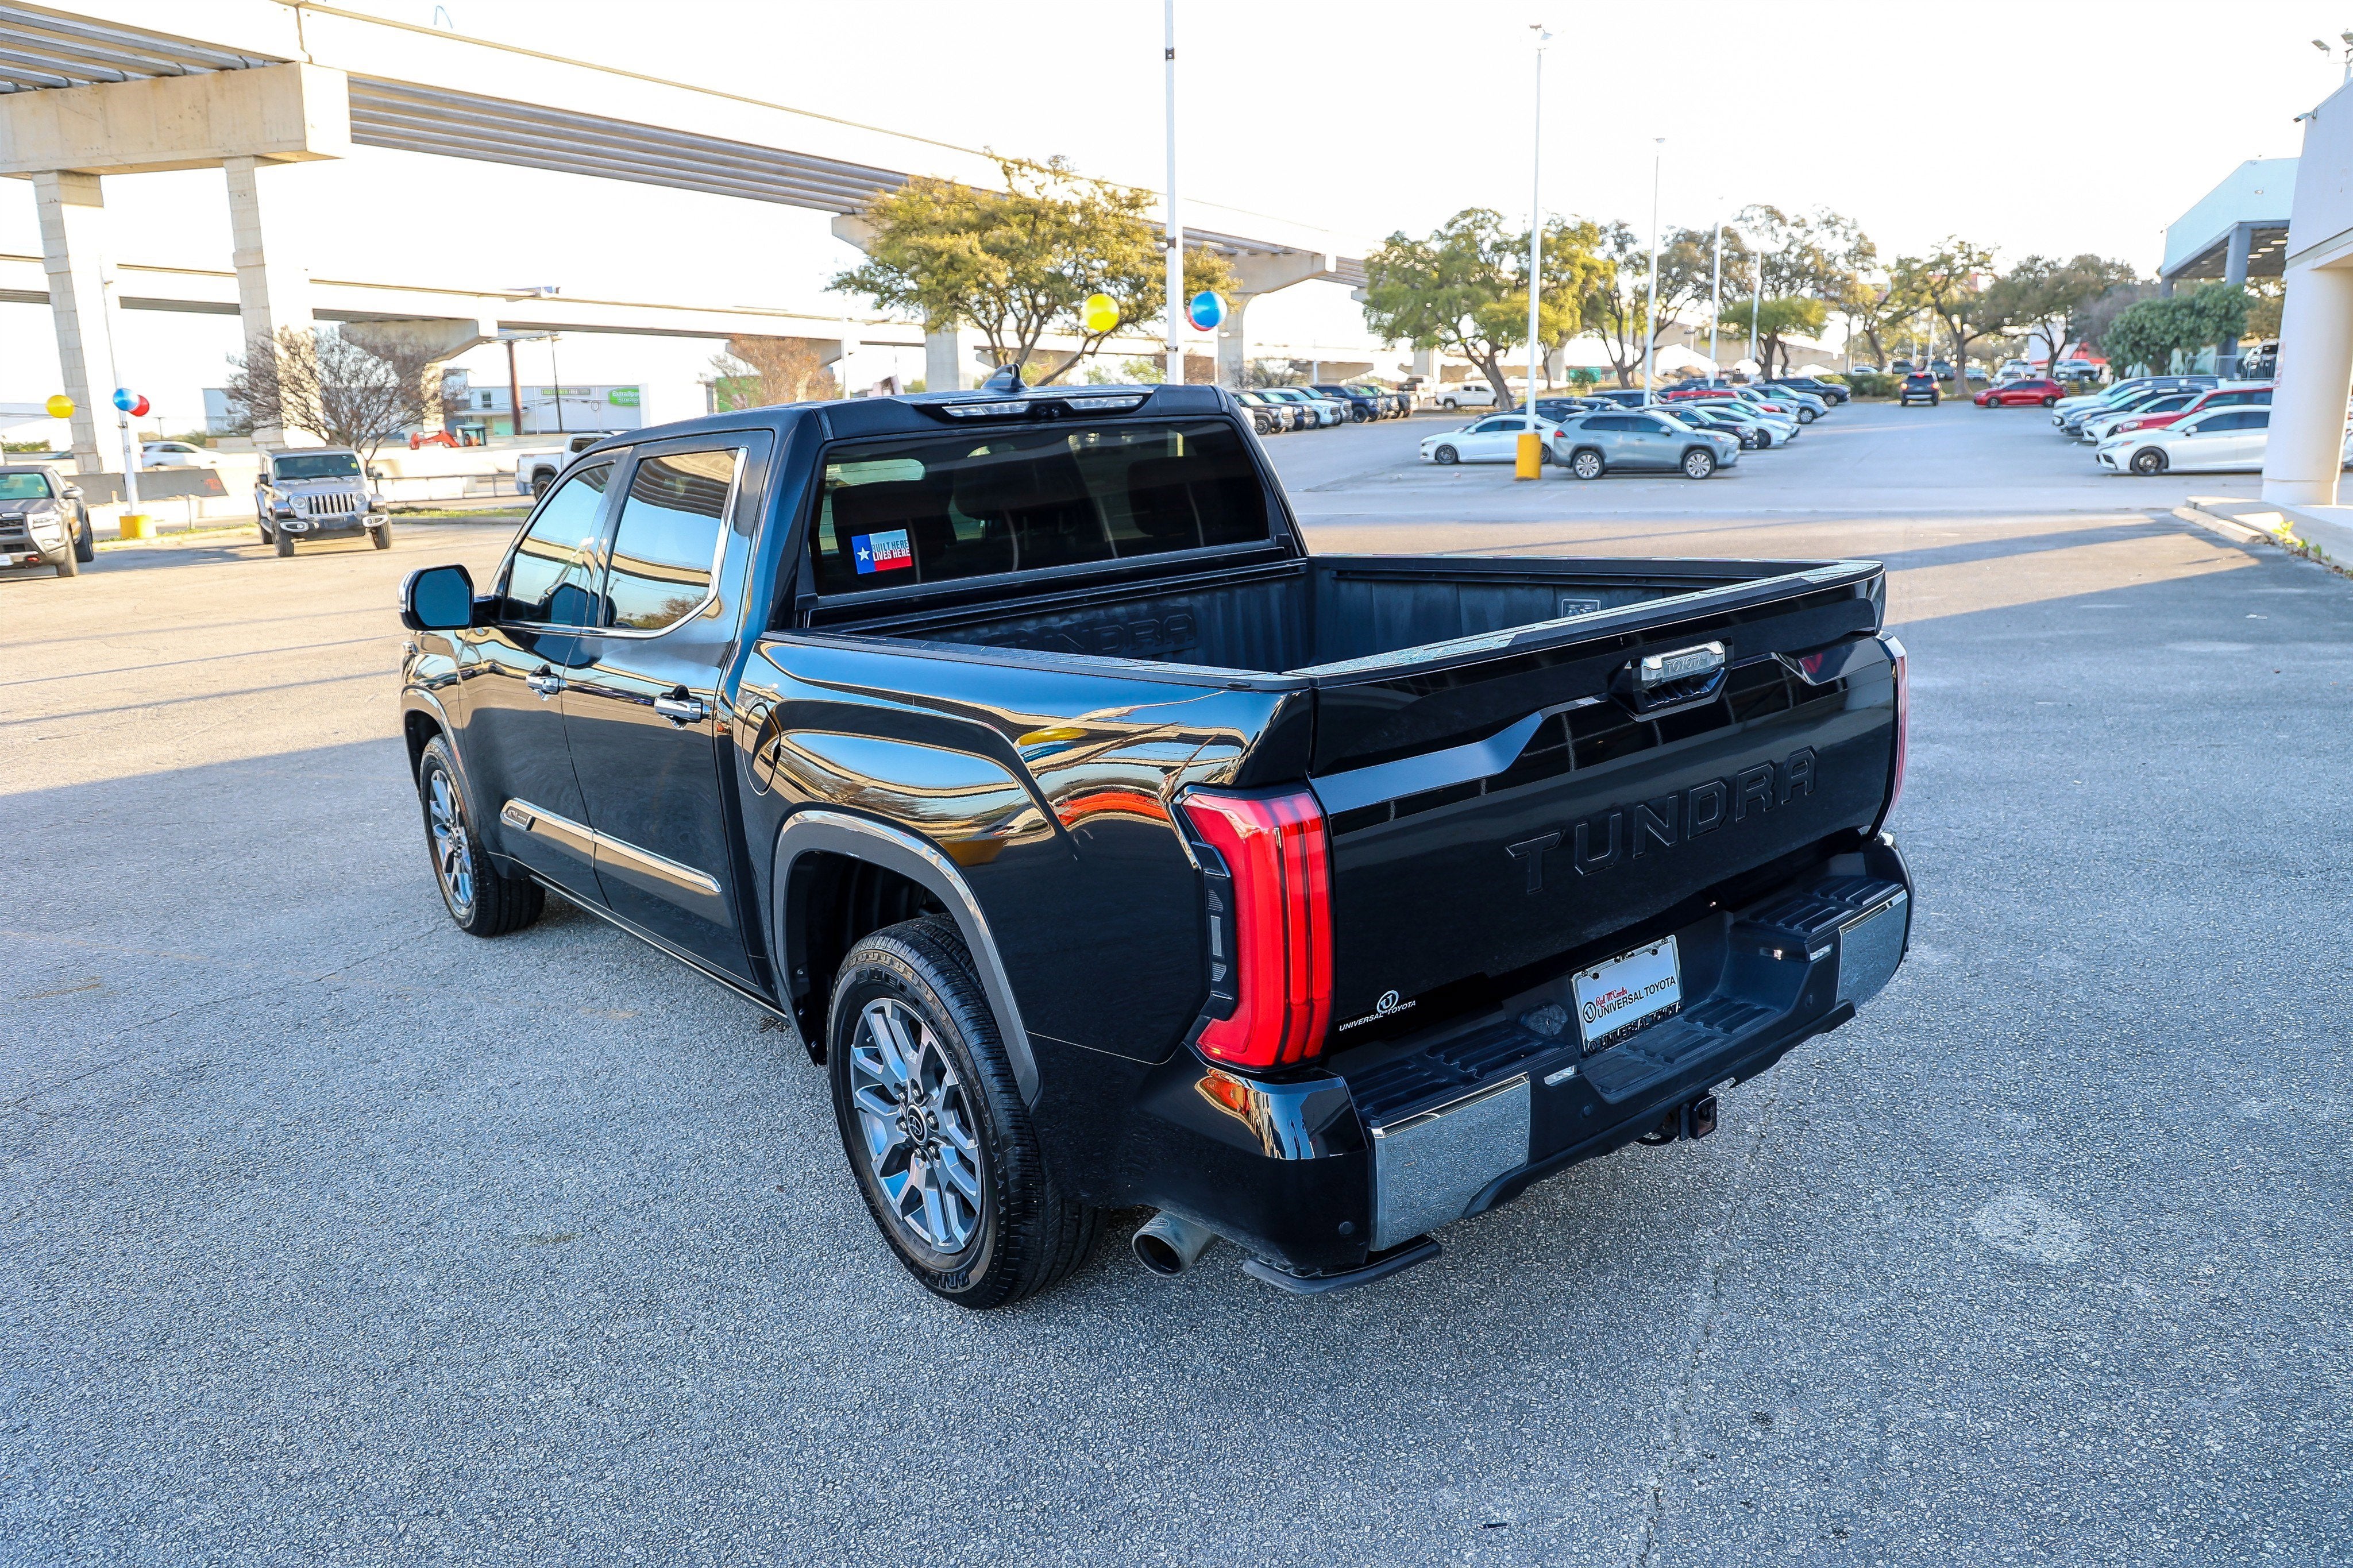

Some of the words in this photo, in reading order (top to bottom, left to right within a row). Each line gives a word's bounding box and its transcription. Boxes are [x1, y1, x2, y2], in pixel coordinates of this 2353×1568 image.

[872, 542, 891, 552] BUILT
[891, 539, 908, 550] HERE
[873, 550, 892, 561] LIVES
[892, 548, 911, 558] HERE
[1667, 655, 1703, 673] TOYOTA
[1506, 745, 1817, 894] TUNDRA
[1596, 996, 1606, 1008] Red
[1598, 990, 1644, 1018] UNIVERSAL
[1644, 975, 1676, 997] TOYOTA
[1339, 1013, 1383, 1031] UNIVERSAL
[1388, 1000, 1416, 1015] TOYOTA
[1599, 1015, 1649, 1047] UNIVERSAL
[1648, 1002, 1682, 1025] TOYOTA
